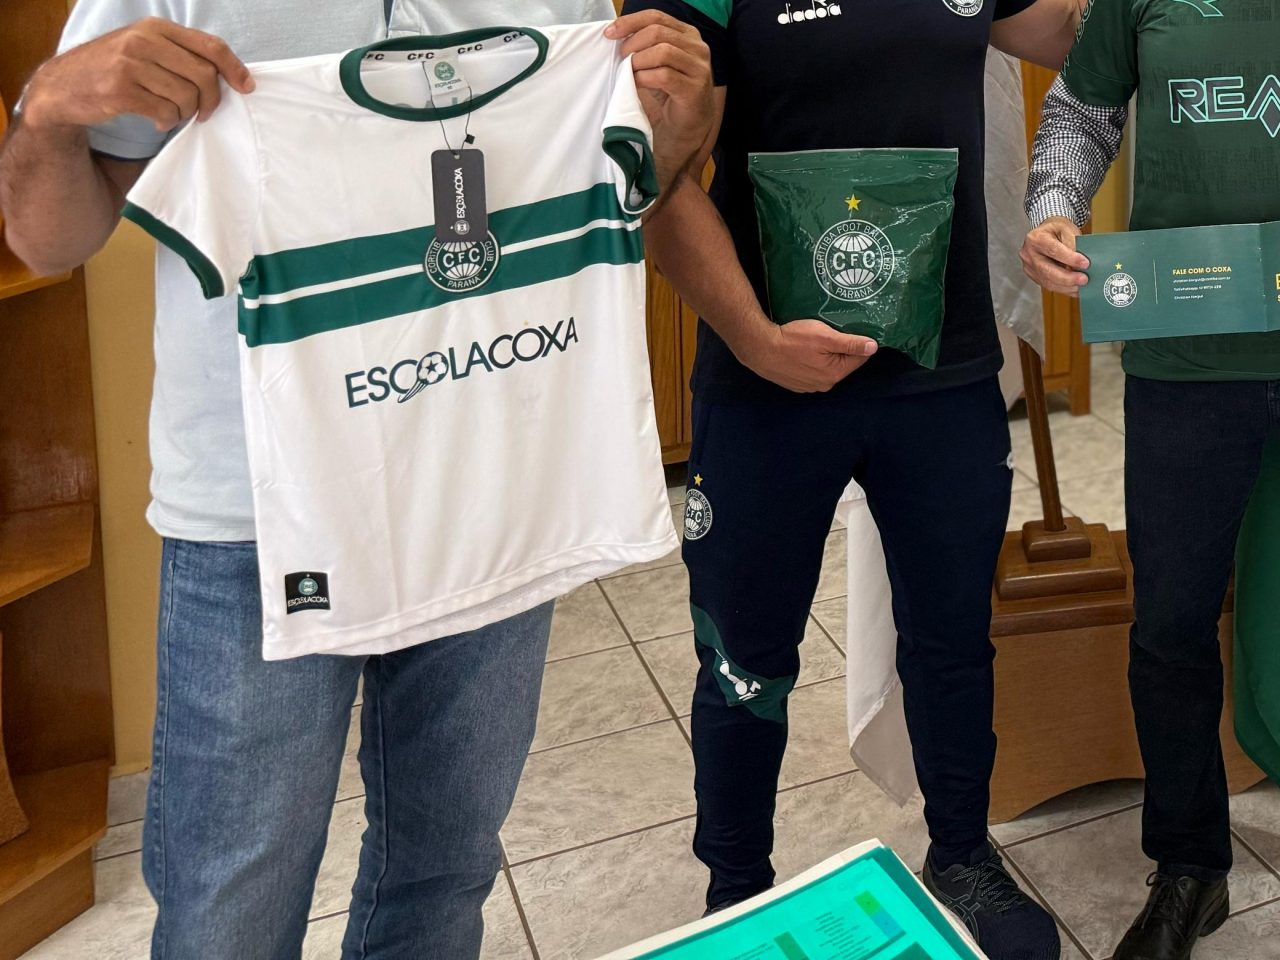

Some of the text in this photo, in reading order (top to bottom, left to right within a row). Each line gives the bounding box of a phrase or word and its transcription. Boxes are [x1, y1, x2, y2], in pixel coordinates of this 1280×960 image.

[362, 53, 385, 61] FC
[407, 52, 435, 61] CFC
[457, 43, 483, 55] CFC
[427, 241, 494, 274] CORITIB CLUB
[442, 247, 480, 268] CFC
[816, 232, 837, 275] CORITIBA
[837, 223, 861, 234] FOOT
[863, 226, 884, 244] BALL
[832, 250, 876, 271] CFC
[1172, 268, 1187, 276] FALE
[1187, 267, 1205, 275] COM
[1212, 265, 1233, 273] COXA
[1111, 286, 1130, 295] CFC
[345, 317, 579, 408] ESCOLACOXA
